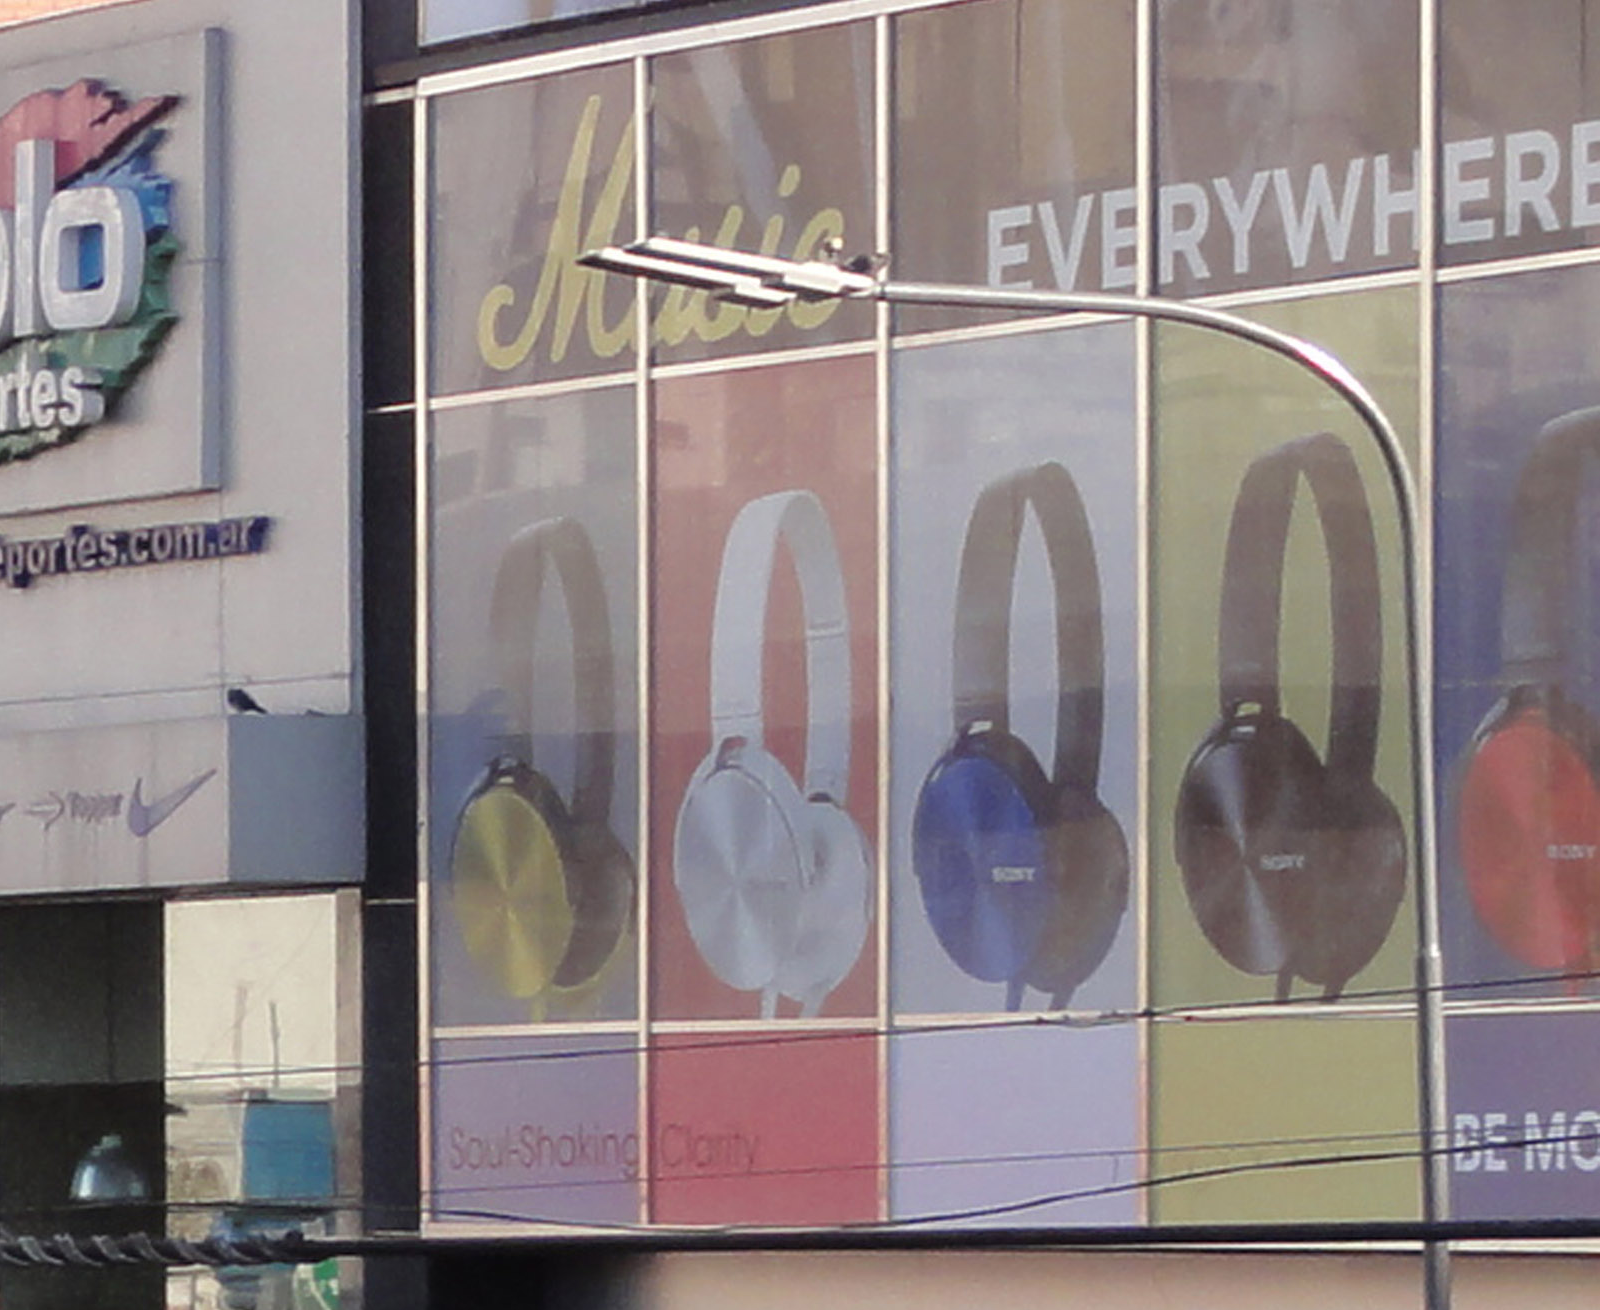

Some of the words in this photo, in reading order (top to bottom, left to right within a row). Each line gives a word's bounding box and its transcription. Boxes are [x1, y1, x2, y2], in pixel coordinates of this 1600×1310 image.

[477, 93, 845, 370] Music
[986, 119, 1600, 291] EVERYWHERE
[448, 1125, 640, 1180] Soul-Shaking
[660, 1126, 760, 1170] Clarity
